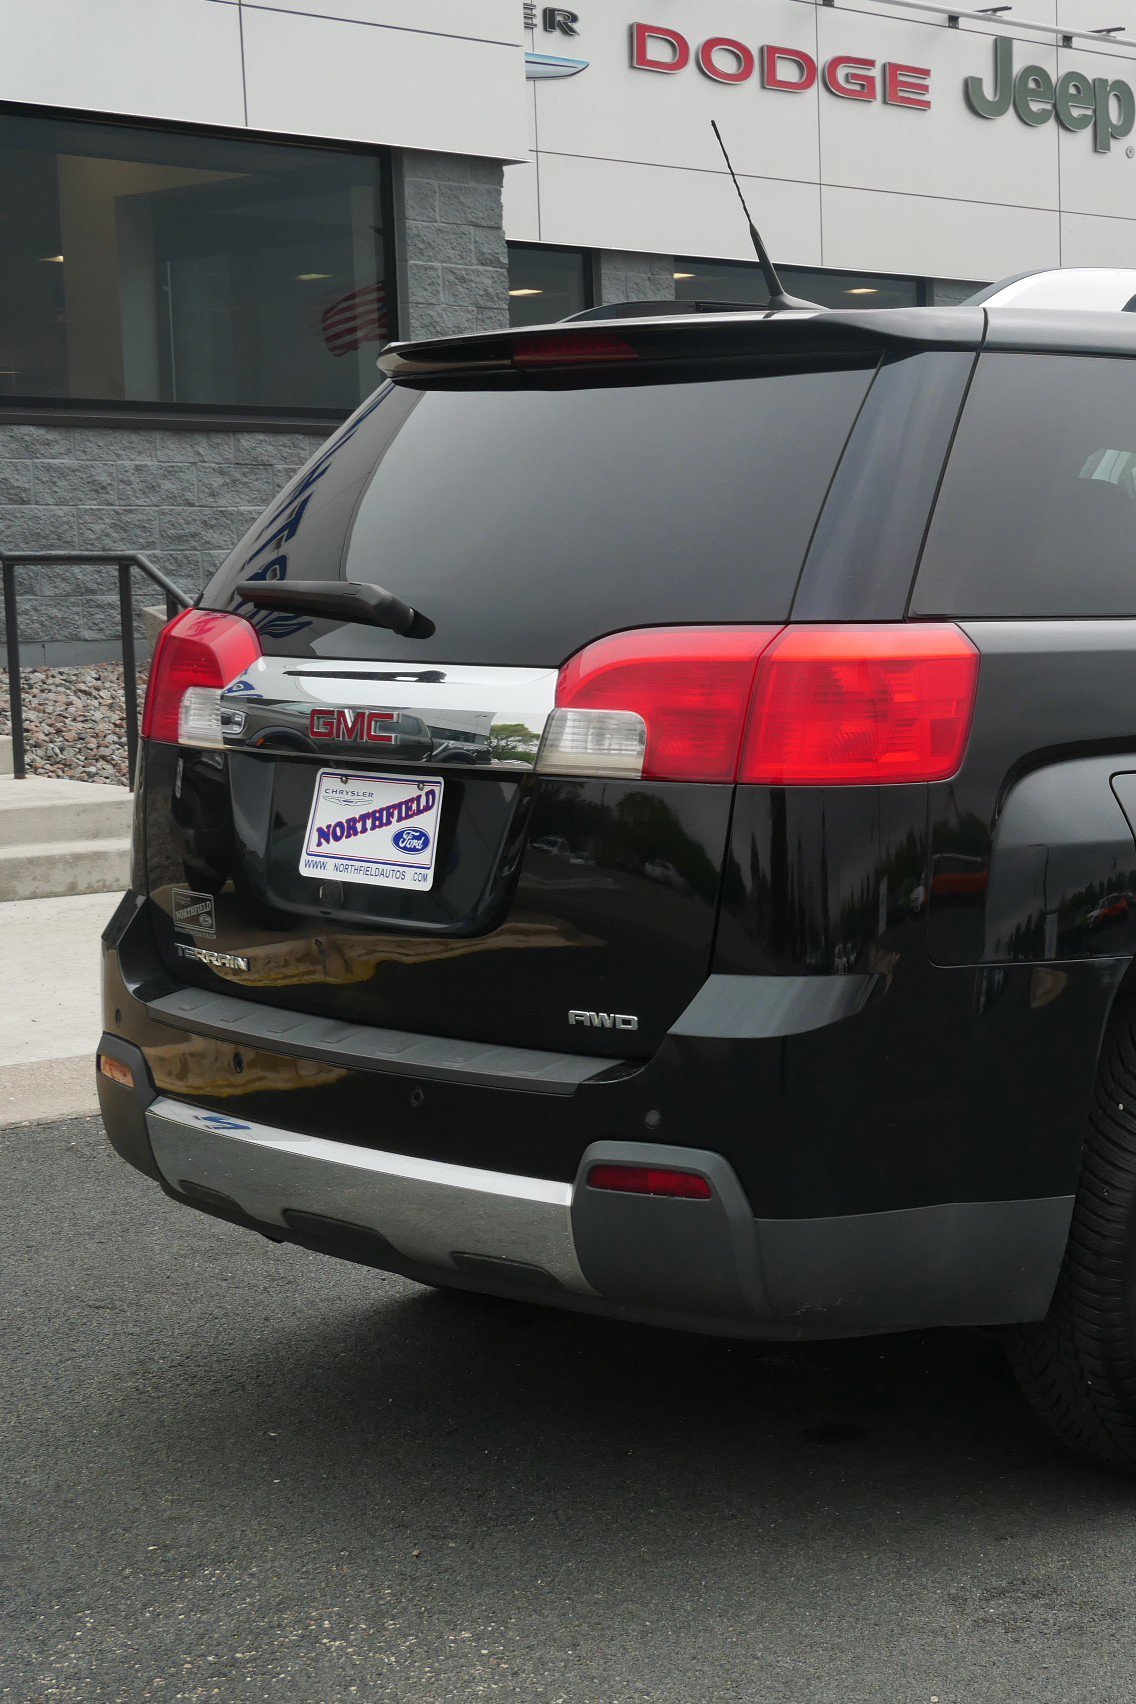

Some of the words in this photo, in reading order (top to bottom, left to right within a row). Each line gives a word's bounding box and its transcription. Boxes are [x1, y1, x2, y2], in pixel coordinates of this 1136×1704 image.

[630, 22, 931, 111] DODGE
[964, 36, 1136, 153] Jeep
[309, 708, 401, 745] GMC
[324, 788, 374, 799] CHRYSLER
[316, 788, 436, 848] NORTHFIELD
[399, 830, 425, 850] Ford
[333, 862, 406, 881] NORTHFIELDAUTOS
[174, 942, 249, 972] TERRAIN
[568, 1010, 638, 1031] AWD
